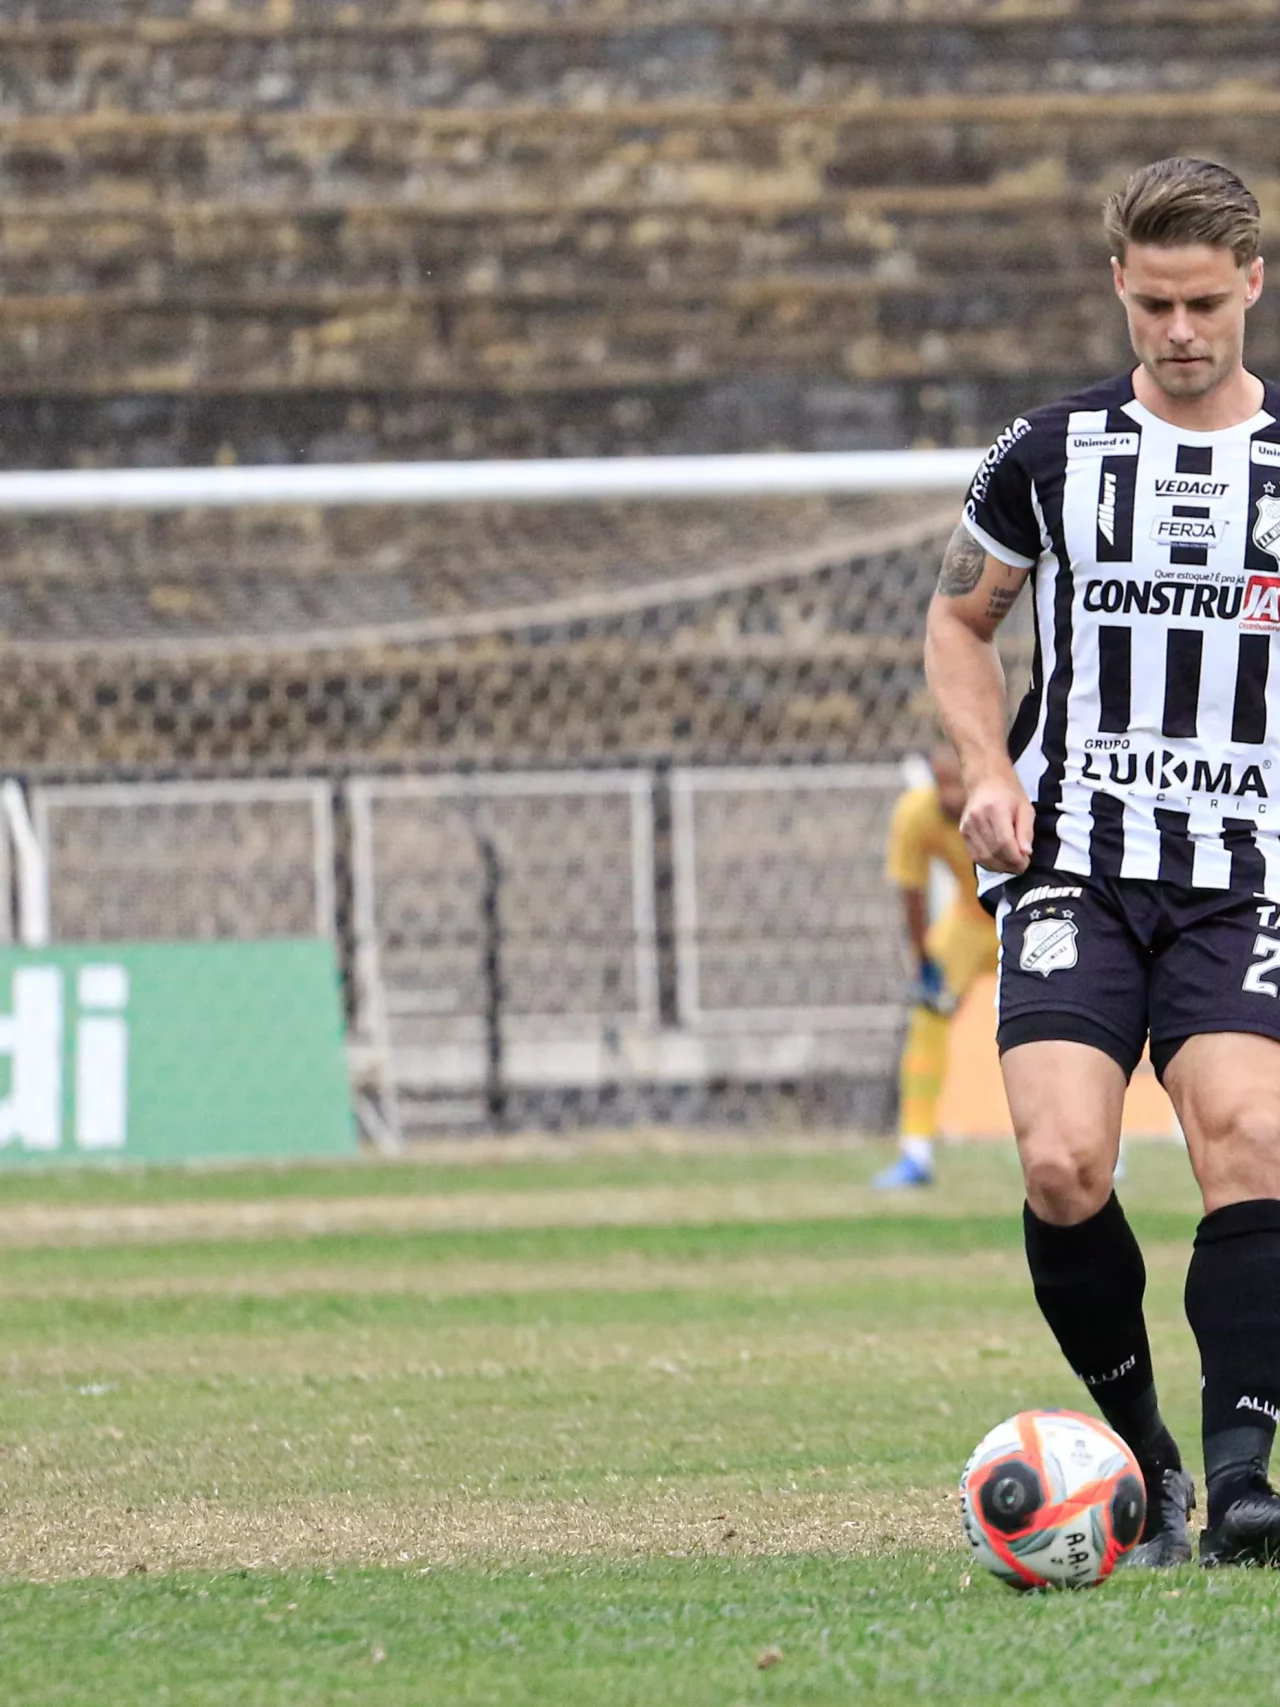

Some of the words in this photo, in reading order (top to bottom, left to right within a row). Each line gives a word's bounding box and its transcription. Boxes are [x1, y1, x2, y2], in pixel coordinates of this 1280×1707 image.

[1074, 438, 1117, 447] Unimed
[1155, 479, 1230, 495] VEDACIT
[1154, 570, 1175, 579] Quer
[1176, 572, 1214, 584] estoque?
[1221, 577, 1235, 585] pra
[1084, 739, 1130, 750] GRUPO
[1082, 750, 1268, 798] LUKMA
